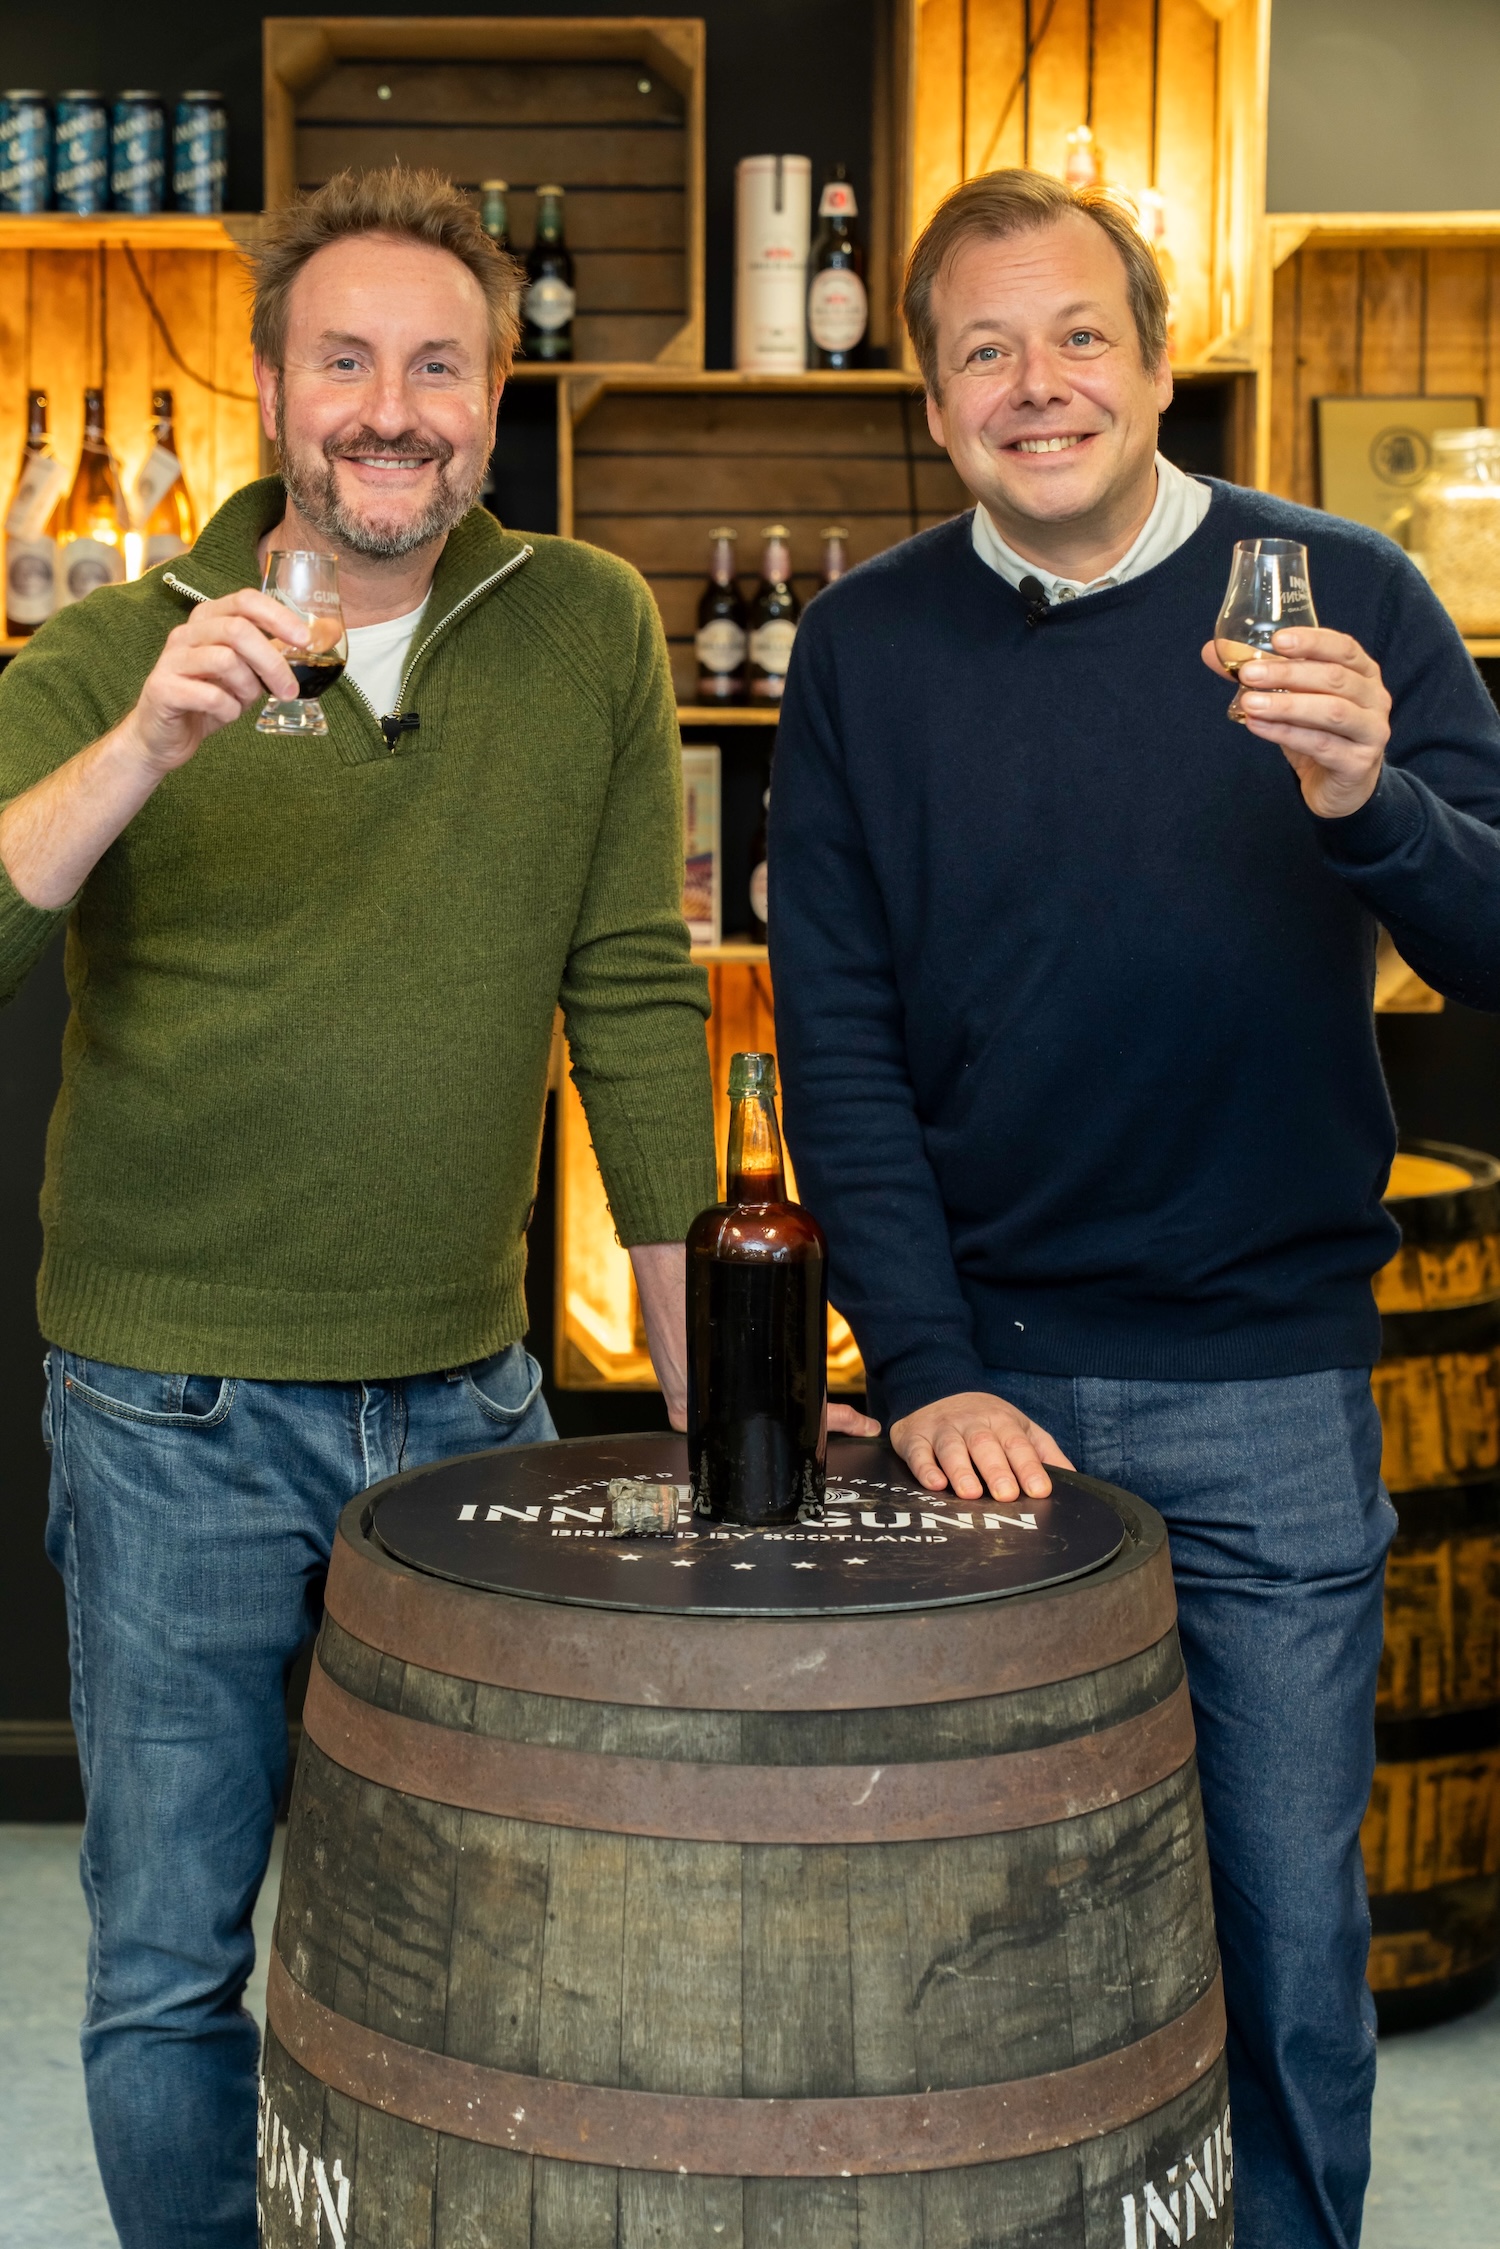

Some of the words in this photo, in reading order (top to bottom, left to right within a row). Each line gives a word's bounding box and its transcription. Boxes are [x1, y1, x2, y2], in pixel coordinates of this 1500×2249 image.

[548, 1472, 673, 1501] MATUED
[826, 1475, 948, 1508] ARACTER
[457, 1504, 692, 1524] INN
[800, 1510, 1039, 1530] GUNN
[551, 1529, 699, 1539] BRED
[709, 1531, 754, 1540] BY
[763, 1533, 948, 1543] SCOTLAND
